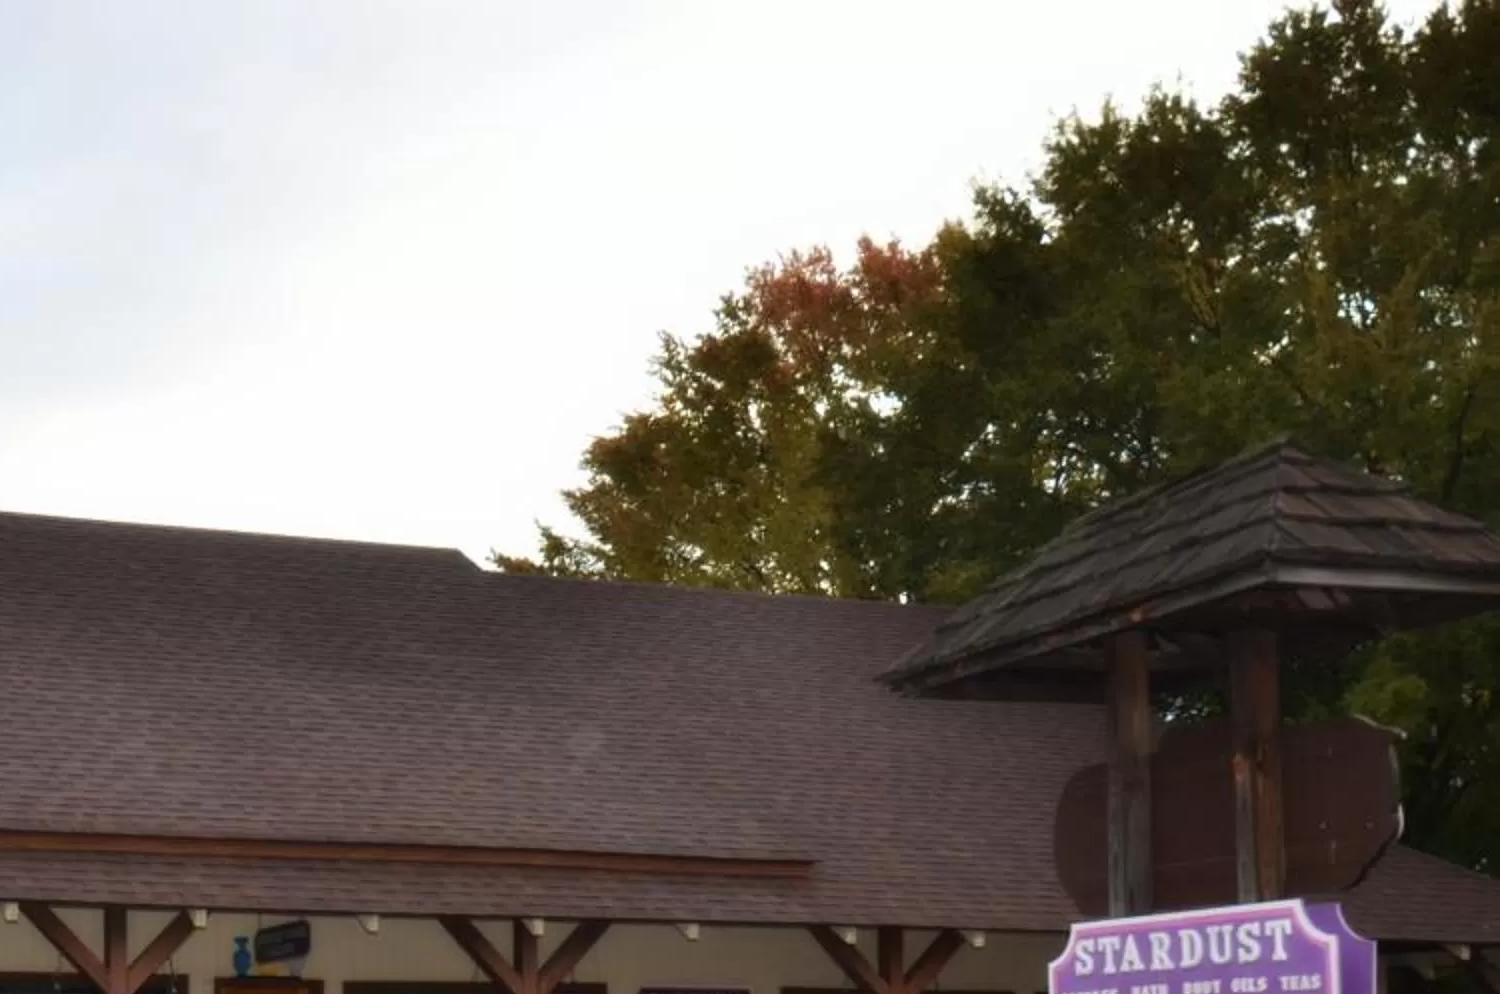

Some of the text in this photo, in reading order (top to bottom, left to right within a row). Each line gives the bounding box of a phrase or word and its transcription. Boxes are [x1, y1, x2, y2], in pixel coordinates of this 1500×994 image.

[1074, 918, 1292, 976] STARDUST
[1230, 976, 1268, 993] OILS
[1278, 972, 1322, 992] TEAS
